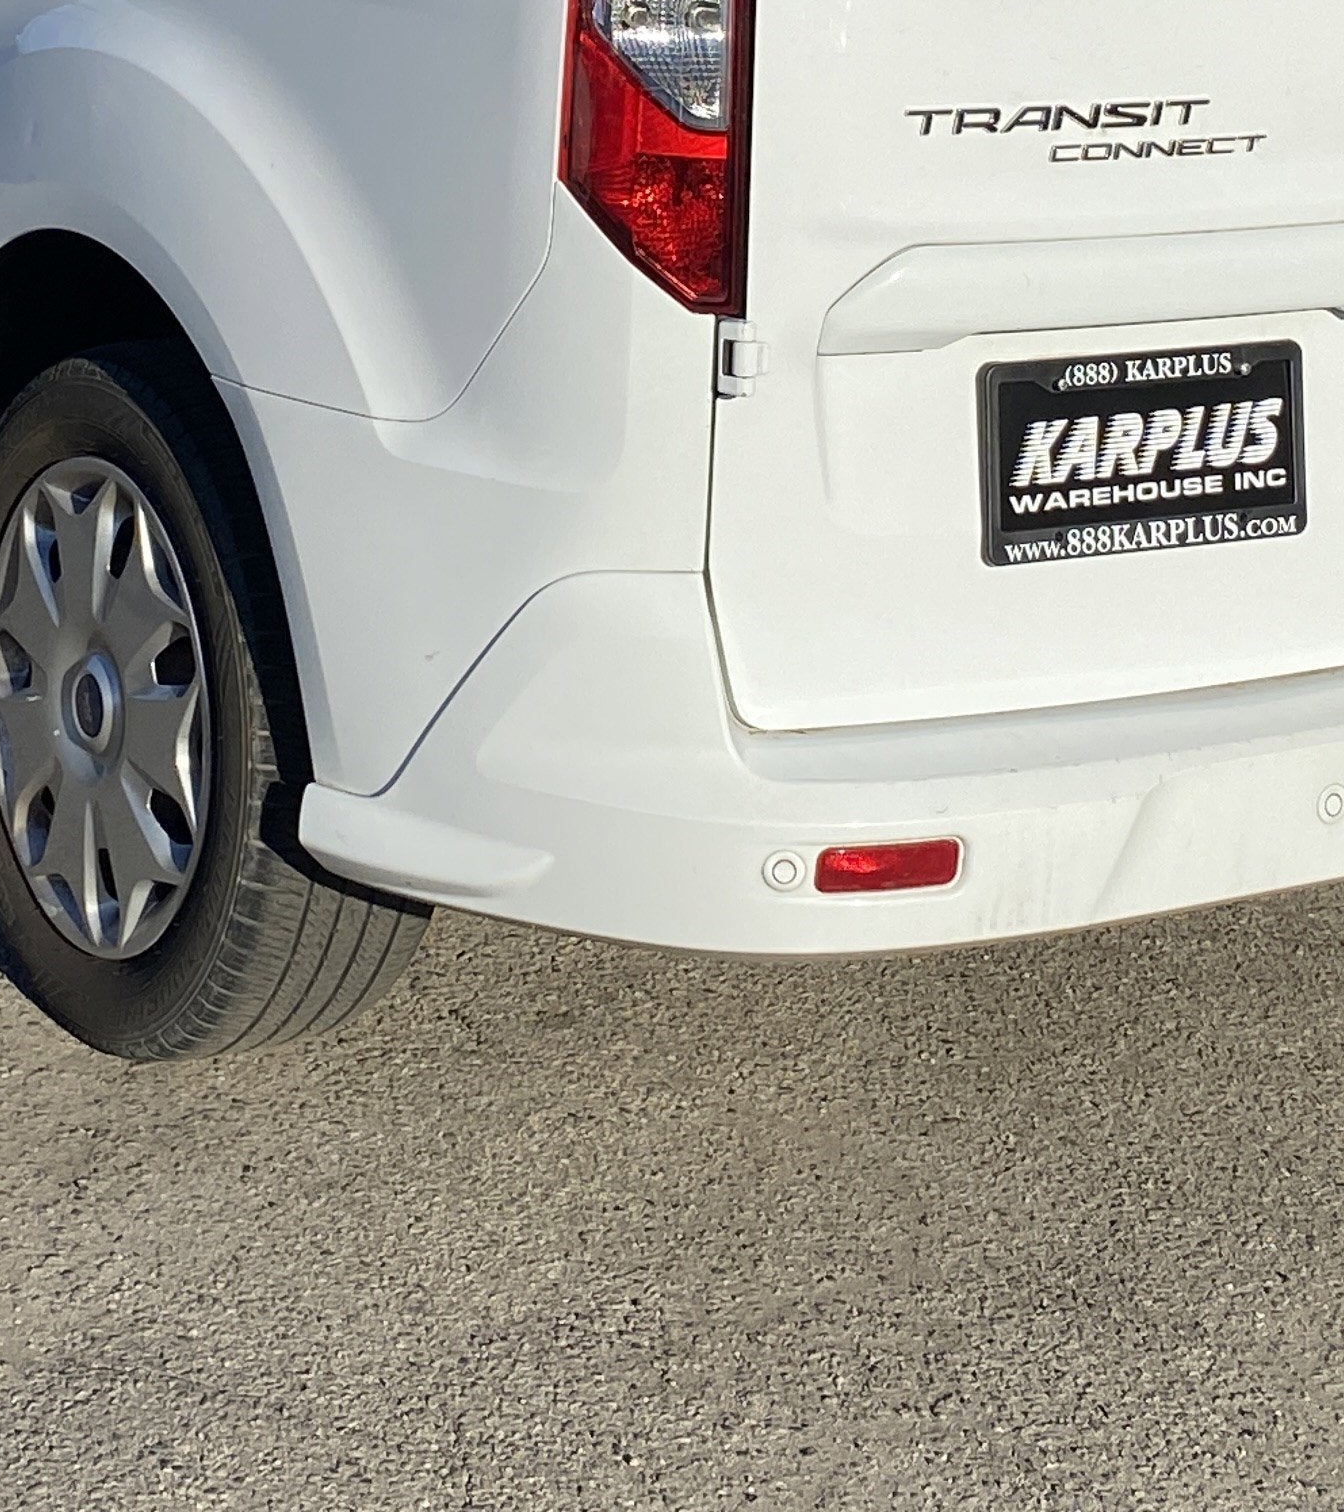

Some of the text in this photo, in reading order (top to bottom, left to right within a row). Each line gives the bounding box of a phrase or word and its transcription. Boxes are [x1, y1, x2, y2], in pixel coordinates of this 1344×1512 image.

[905, 99, 1210, 136] TRANSIT
[1048, 134, 1267, 163] CONNECT
[1063, 352, 1232, 387] (888) KARPLUS
[1009, 397, 1283, 488] KARPLUS
[1009, 468, 1287, 514] WAREHOUSE INC
